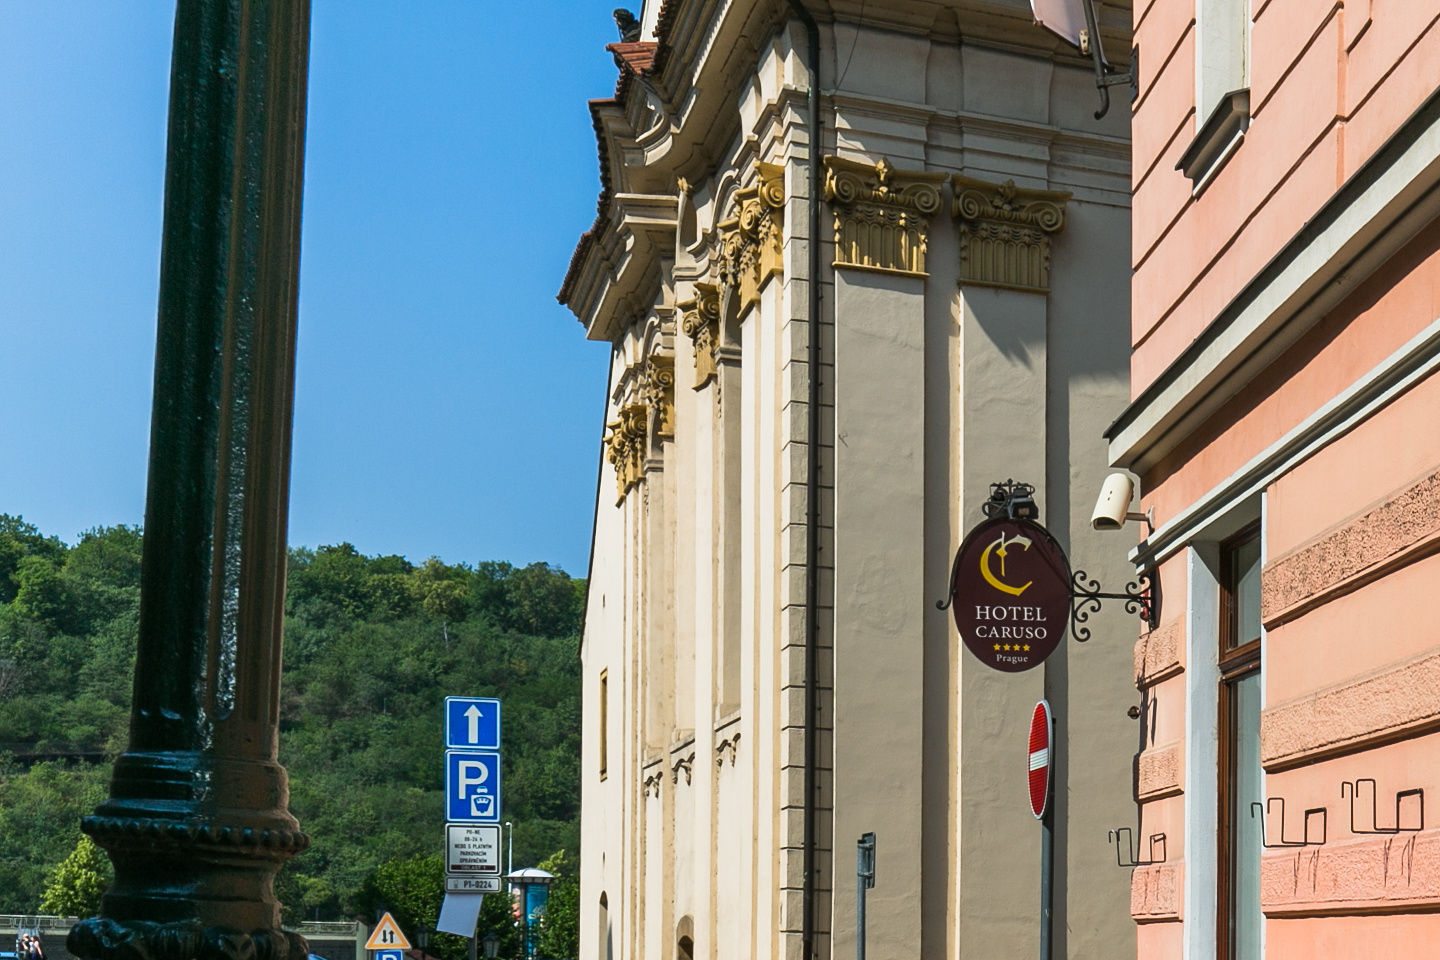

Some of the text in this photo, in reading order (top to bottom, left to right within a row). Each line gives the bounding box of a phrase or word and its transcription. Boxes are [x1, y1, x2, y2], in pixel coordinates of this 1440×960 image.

[975, 605, 1047, 622] HOTEL
[975, 625, 1047, 639] CARUSO
[996, 653, 1029, 665] Prague
[458, 760, 489, 800] P
[463, 880, 492, 889] P1-0224
